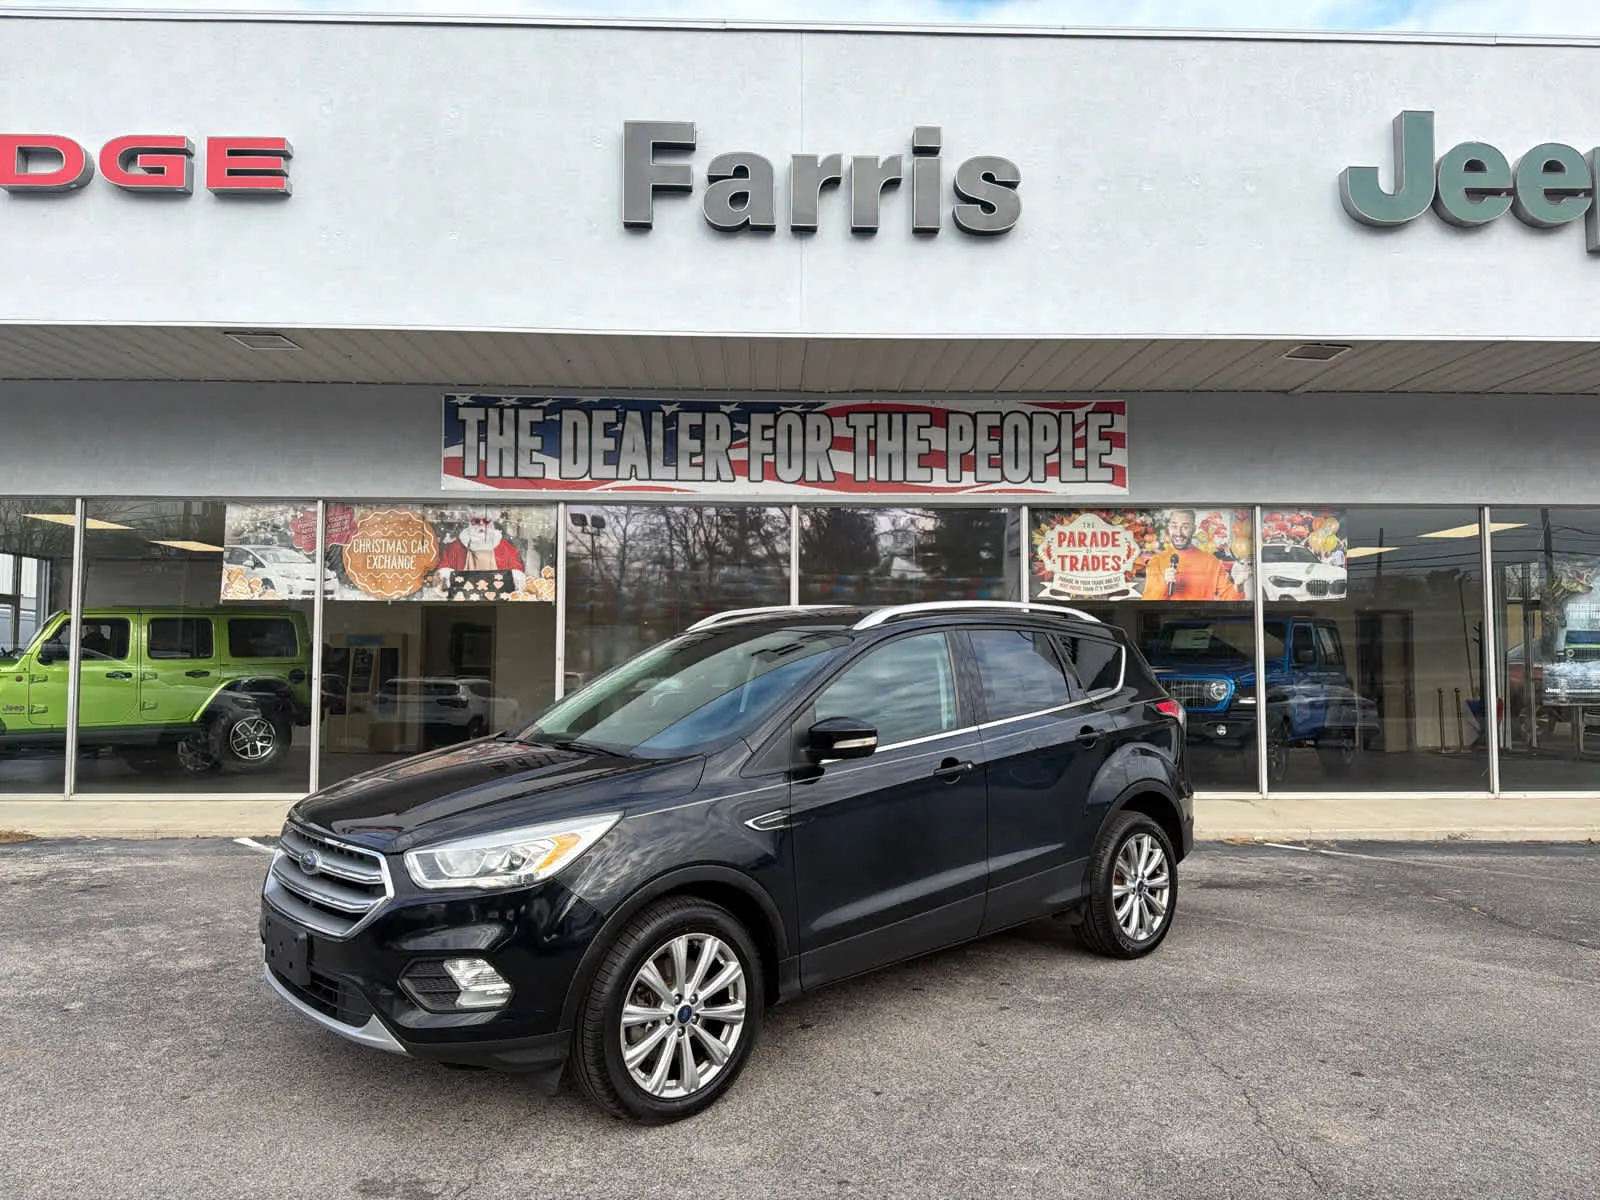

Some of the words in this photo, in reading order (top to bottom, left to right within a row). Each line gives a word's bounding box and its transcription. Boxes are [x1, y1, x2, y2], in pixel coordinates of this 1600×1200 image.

[623, 120, 1022, 236] Farris
[1338, 110, 1600, 253] Jee
[457, 406, 546, 479] THE
[559, 408, 736, 482] DEALER
[748, 410, 836, 483] FOR
[847, 411, 933, 483] THE
[946, 410, 1115, 484] PEOPLE
[353, 538, 408, 554] CHRISTMAS
[410, 539, 430, 554] CAR
[1057, 531, 1121, 548] PARADE
[366, 555, 417, 570] EXCHANGE
[1057, 554, 1122, 572] TRADES
